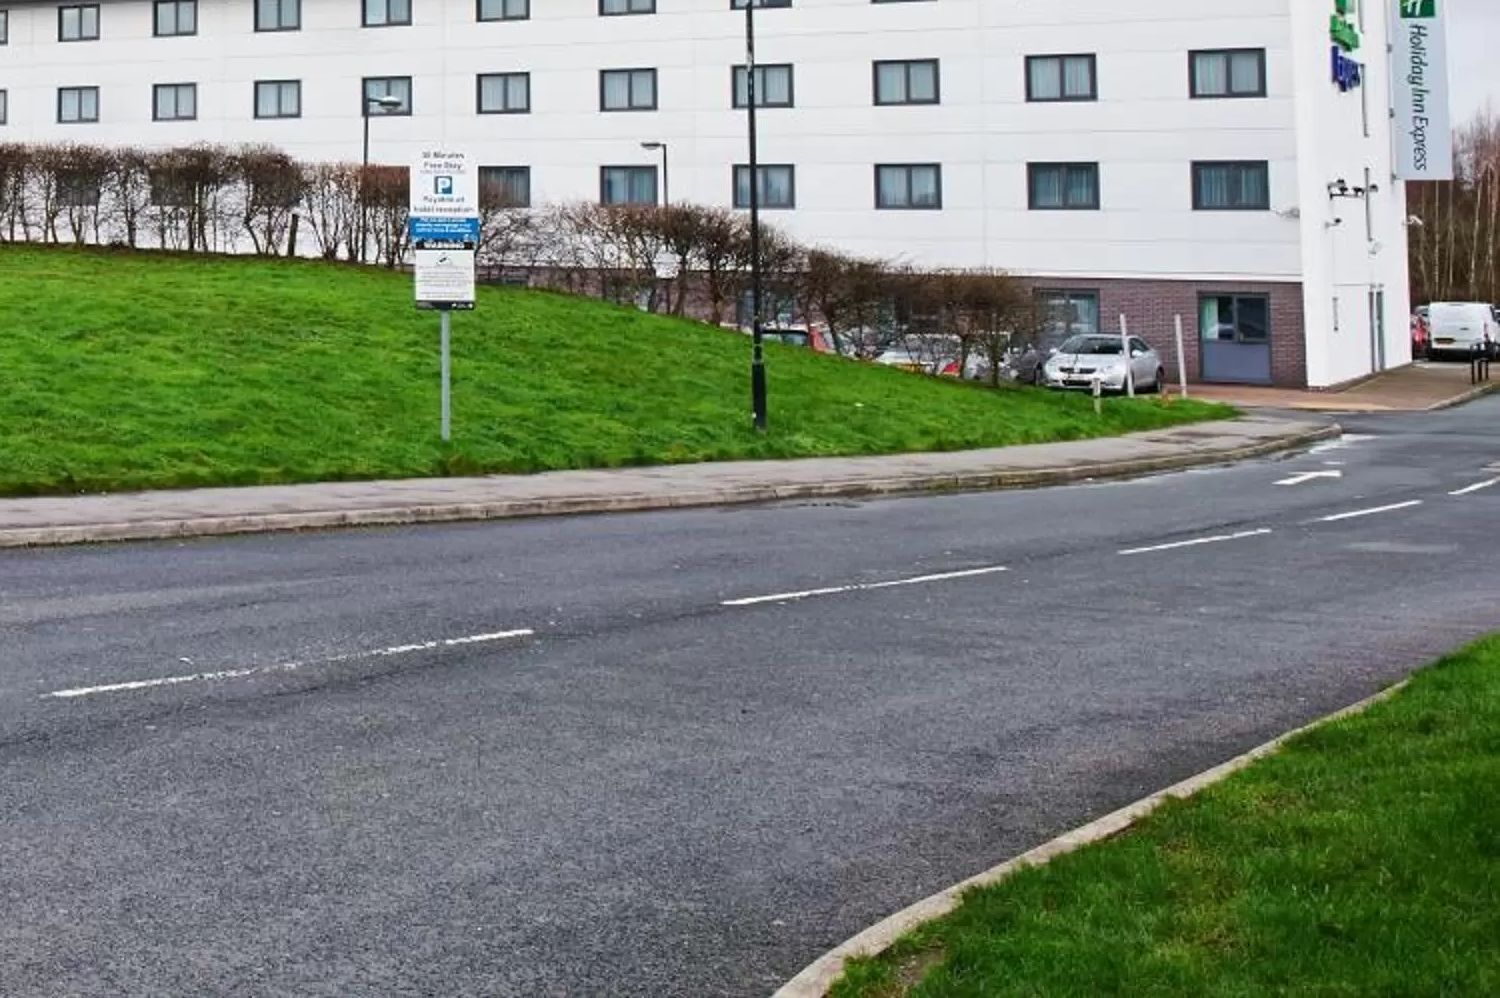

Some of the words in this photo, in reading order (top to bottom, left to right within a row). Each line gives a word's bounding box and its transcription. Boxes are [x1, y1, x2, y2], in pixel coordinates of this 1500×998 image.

[1407, 23, 1429, 87] Holiday
[1411, 88, 1430, 114] Inn
[1409, 115, 1429, 171] Express
